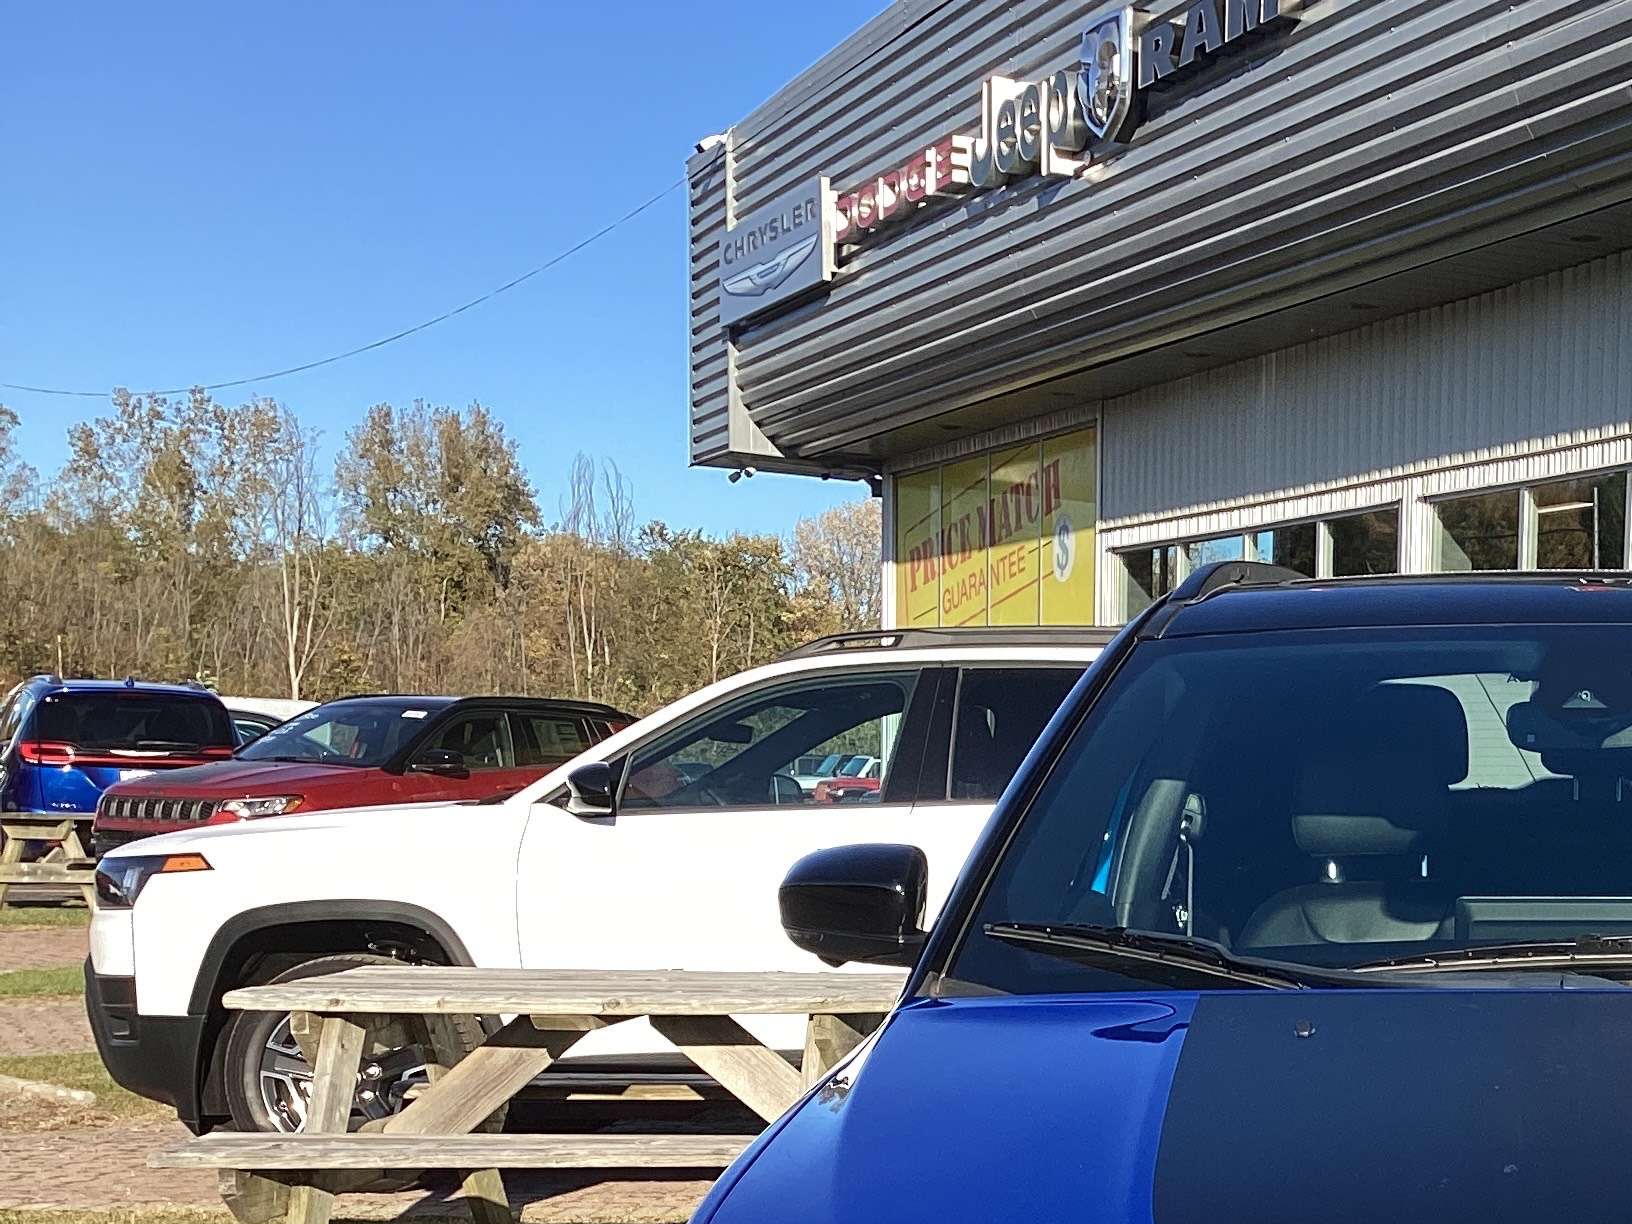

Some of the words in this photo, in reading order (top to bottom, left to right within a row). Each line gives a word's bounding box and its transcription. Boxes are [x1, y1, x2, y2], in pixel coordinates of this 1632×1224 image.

[968, 72, 1088, 187] Jeep
[723, 198, 817, 264] CHRYSLER
[909, 513, 973, 593] PRICE
[976, 459, 1062, 549] MATCH
[943, 544, 1026, 614] GUARANTEE
